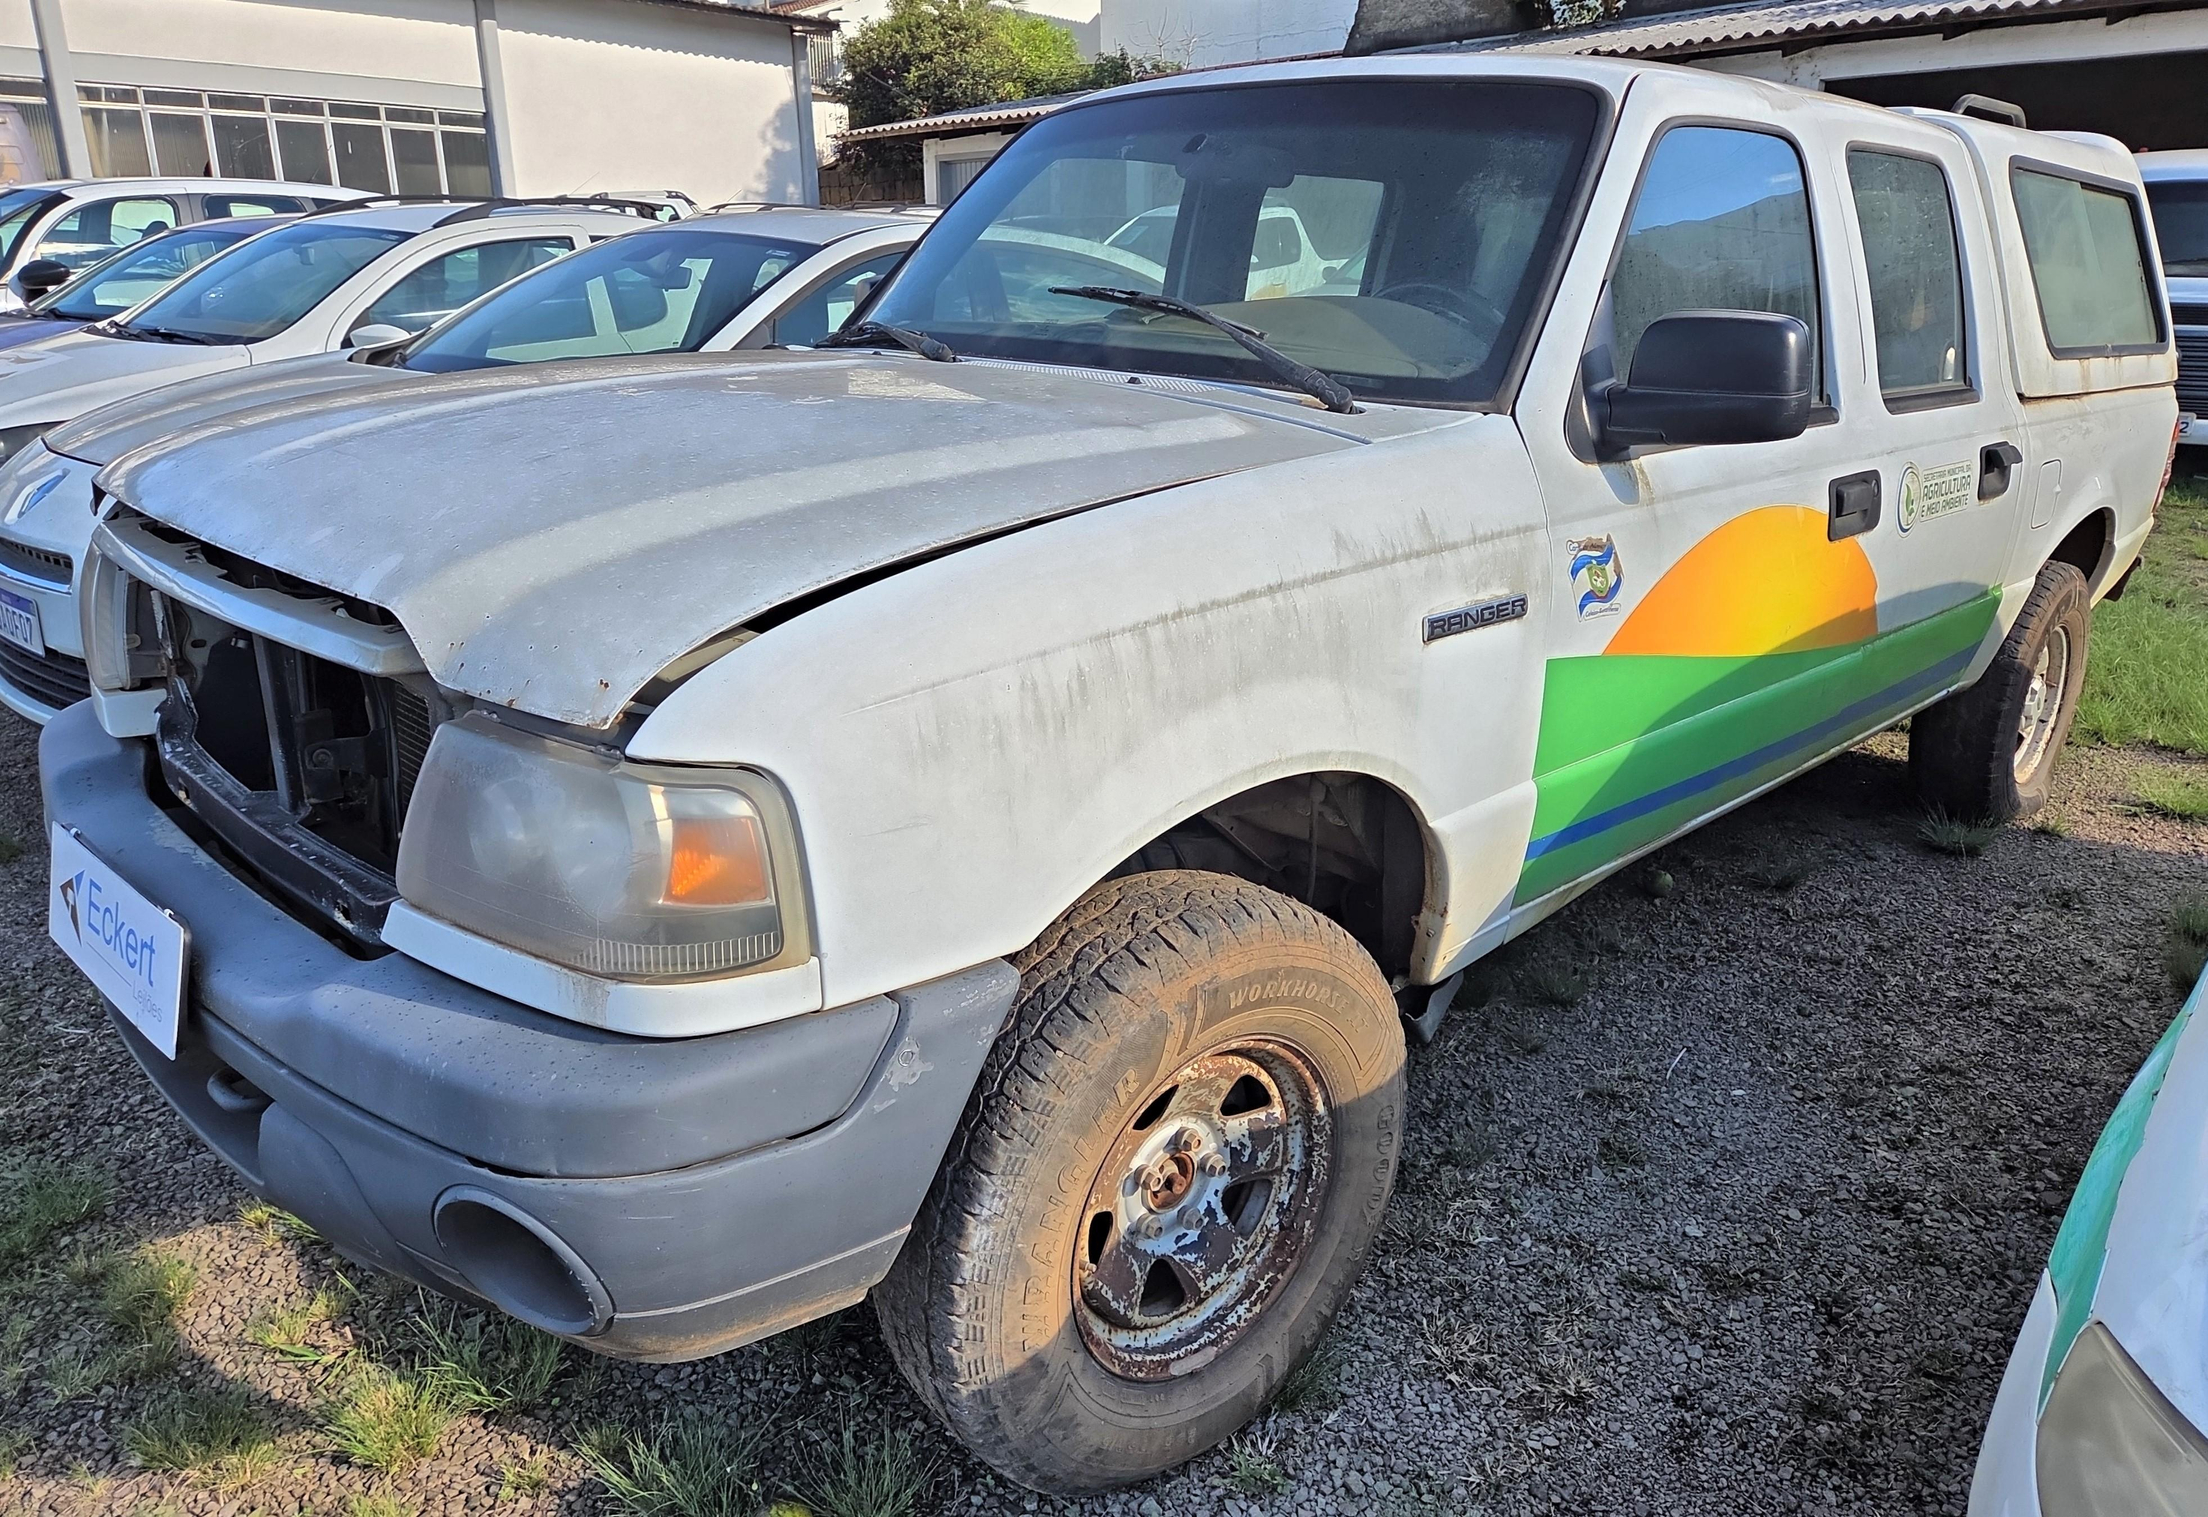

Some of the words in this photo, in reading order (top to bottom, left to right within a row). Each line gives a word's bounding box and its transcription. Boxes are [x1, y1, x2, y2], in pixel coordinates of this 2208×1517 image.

[1921, 504, 1926, 518] E
[1926, 500, 1940, 517] MEIO
[1940, 493, 1969, 512] AMBIENTE
[1922, 474, 1971, 502] AGRICULTURA
[1430, 597, 1526, 636] RANGER
[87, 877, 156, 988] Eckert
[1229, 979, 1351, 1015] WORKHORSE
